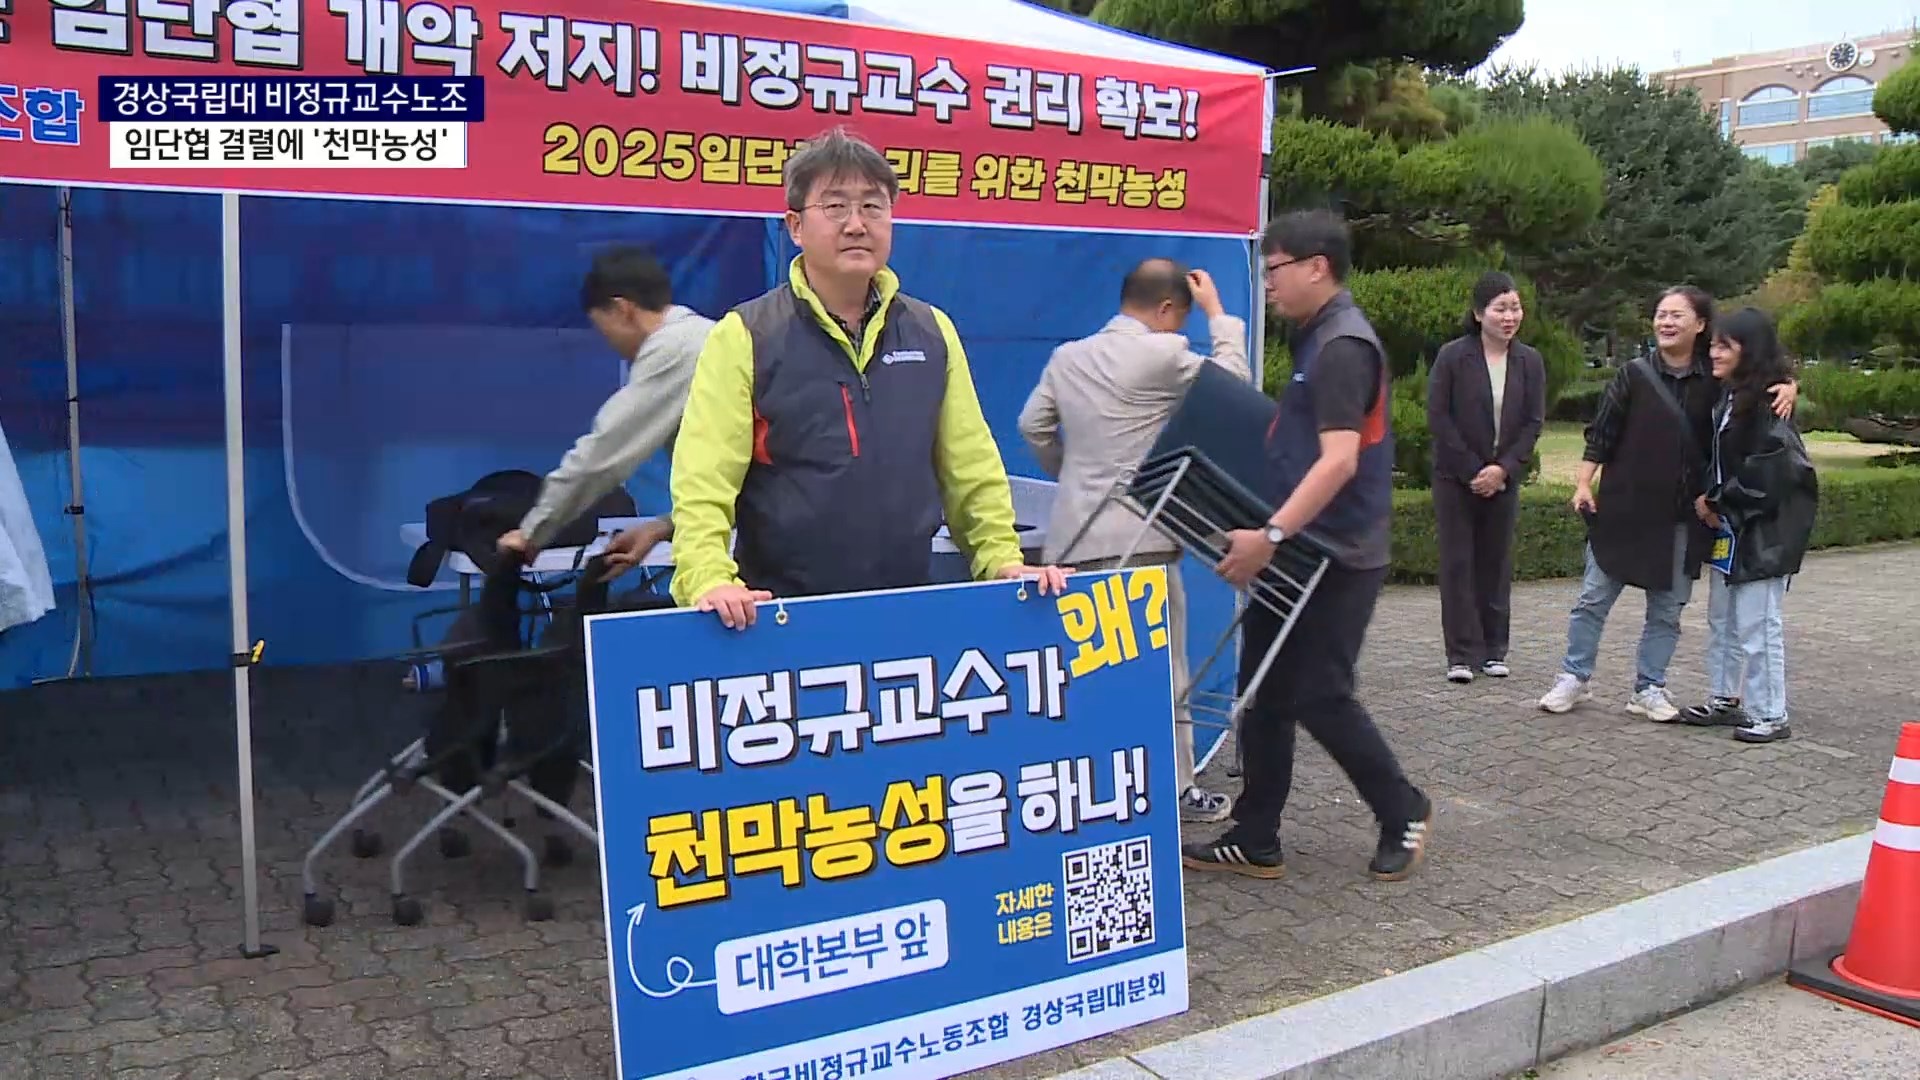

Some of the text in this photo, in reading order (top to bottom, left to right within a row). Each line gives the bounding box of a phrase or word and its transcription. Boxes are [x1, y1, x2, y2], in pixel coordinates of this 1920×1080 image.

[329, 0, 483, 76] 개악
[497, 12, 661, 96] 저지!
[680, 30, 970, 122] 비정규교수
[983, 63, 1083, 134] 권리
[1094, 75, 1200, 141] 확보!
[542, 121, 1187, 210] 2025임단 리를 위한 천막농성
[1057, 566, 1171, 678] 왜?
[636, 645, 1068, 772] 비정규교수가
[645, 745, 1149, 909] 천막농성을 하나!
[995, 882, 1055, 916] 자세한
[998, 911, 1053, 945] 내용은
[734, 912, 932, 993] 대학본부 앞
[1021, 969, 1168, 1031] 경상국립대분회
